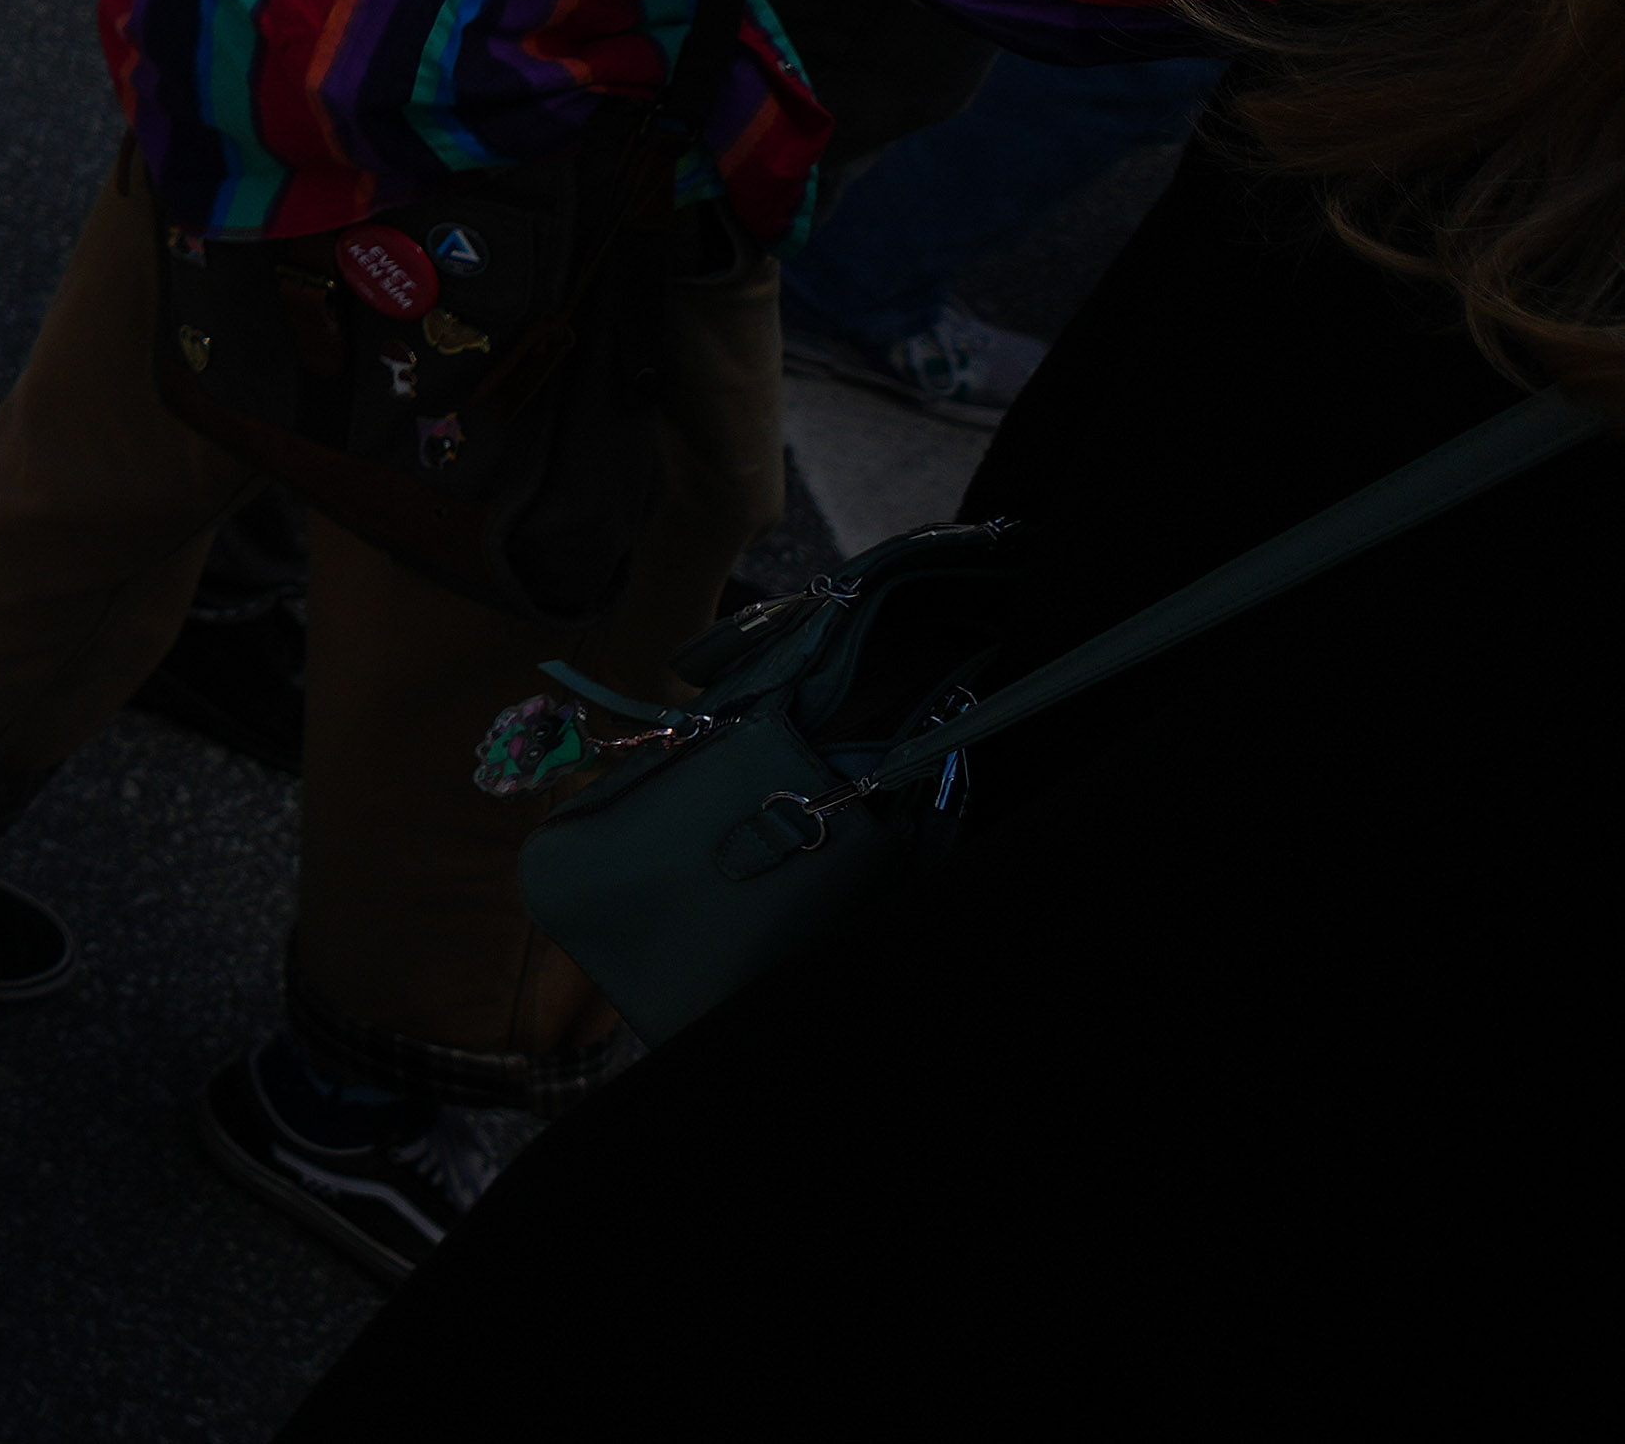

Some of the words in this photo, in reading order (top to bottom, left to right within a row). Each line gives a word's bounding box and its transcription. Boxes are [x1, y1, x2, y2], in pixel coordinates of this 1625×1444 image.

[347, 241, 382, 280] KEN
[378, 275, 415, 312] SIM
[369, 244, 418, 293] EVICT
